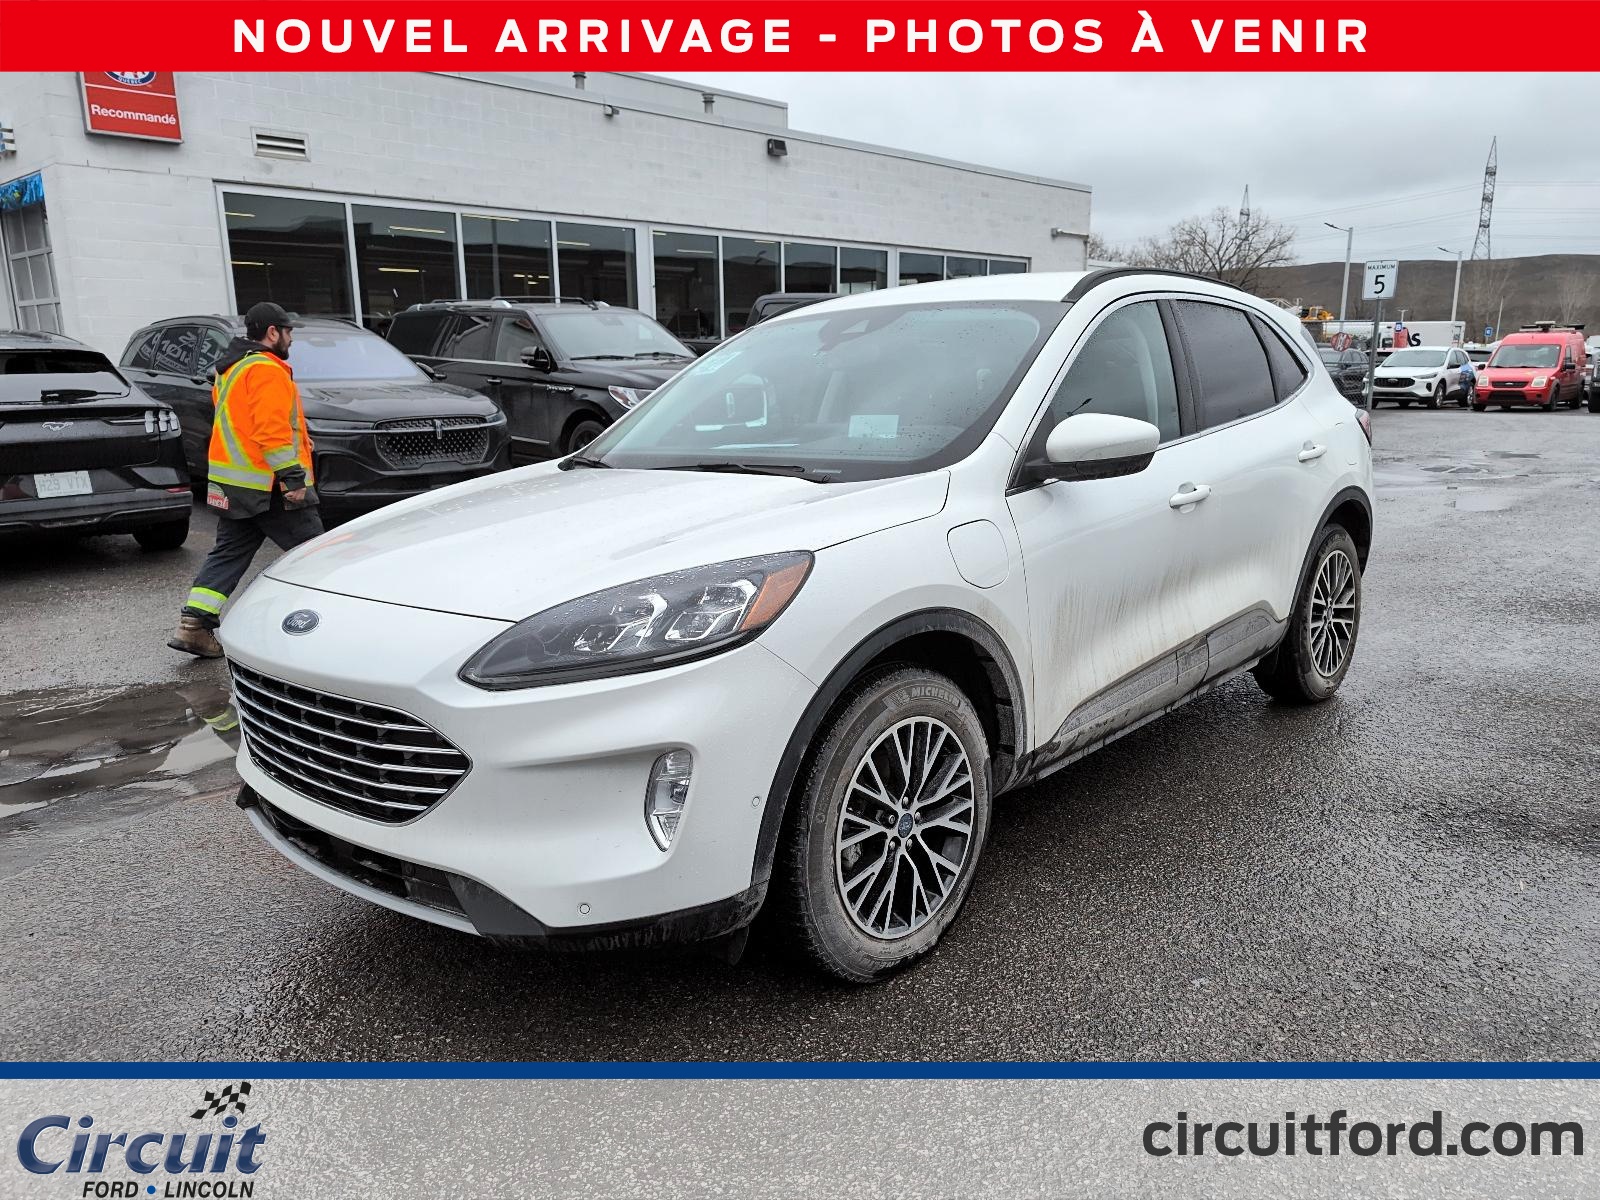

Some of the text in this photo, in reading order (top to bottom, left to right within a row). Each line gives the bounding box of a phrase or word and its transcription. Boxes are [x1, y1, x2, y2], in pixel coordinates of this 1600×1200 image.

[91, 103, 176, 125] Recommandé
[1373, 274, 1385, 295] 5
[910, 686, 960, 707] MICHELIN
